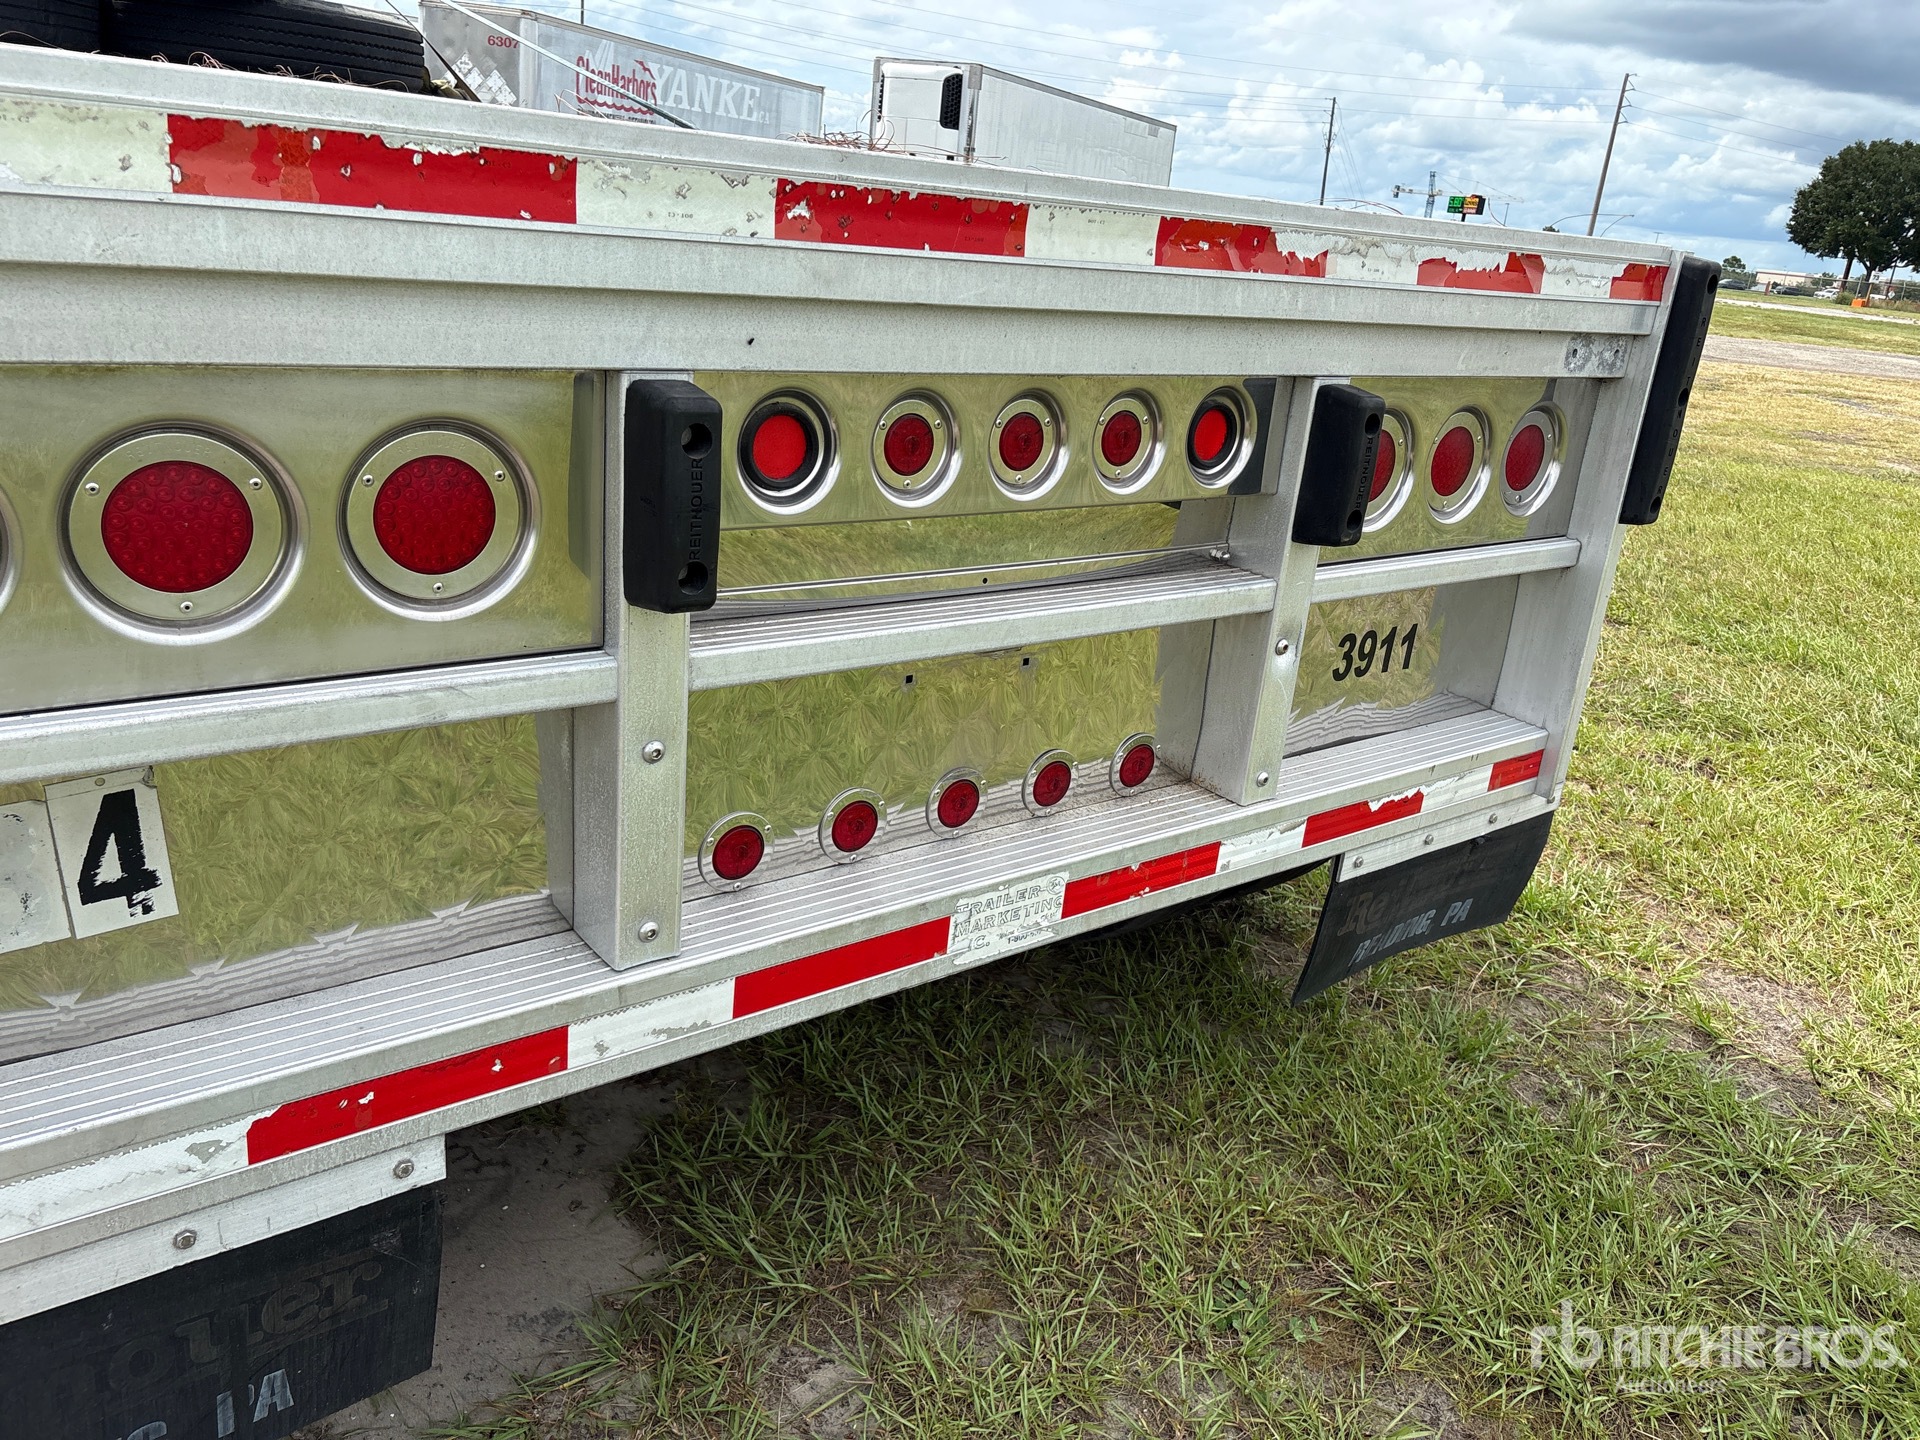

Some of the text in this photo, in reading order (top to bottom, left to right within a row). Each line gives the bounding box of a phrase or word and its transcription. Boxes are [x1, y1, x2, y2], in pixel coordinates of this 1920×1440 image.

[487, 34, 519, 49] 6307
[651, 62, 761, 122] YANKE
[1354, 436, 1375, 510] REITNOUER
[689, 457, 704, 561] REITNOUER
[1332, 623, 1419, 682] 3911
[77, 788, 163, 918] 4
[952, 895, 1063, 938] MARKETING
[955, 884, 1042, 913] TRAILER
[1440, 898, 1474, 927] PA
